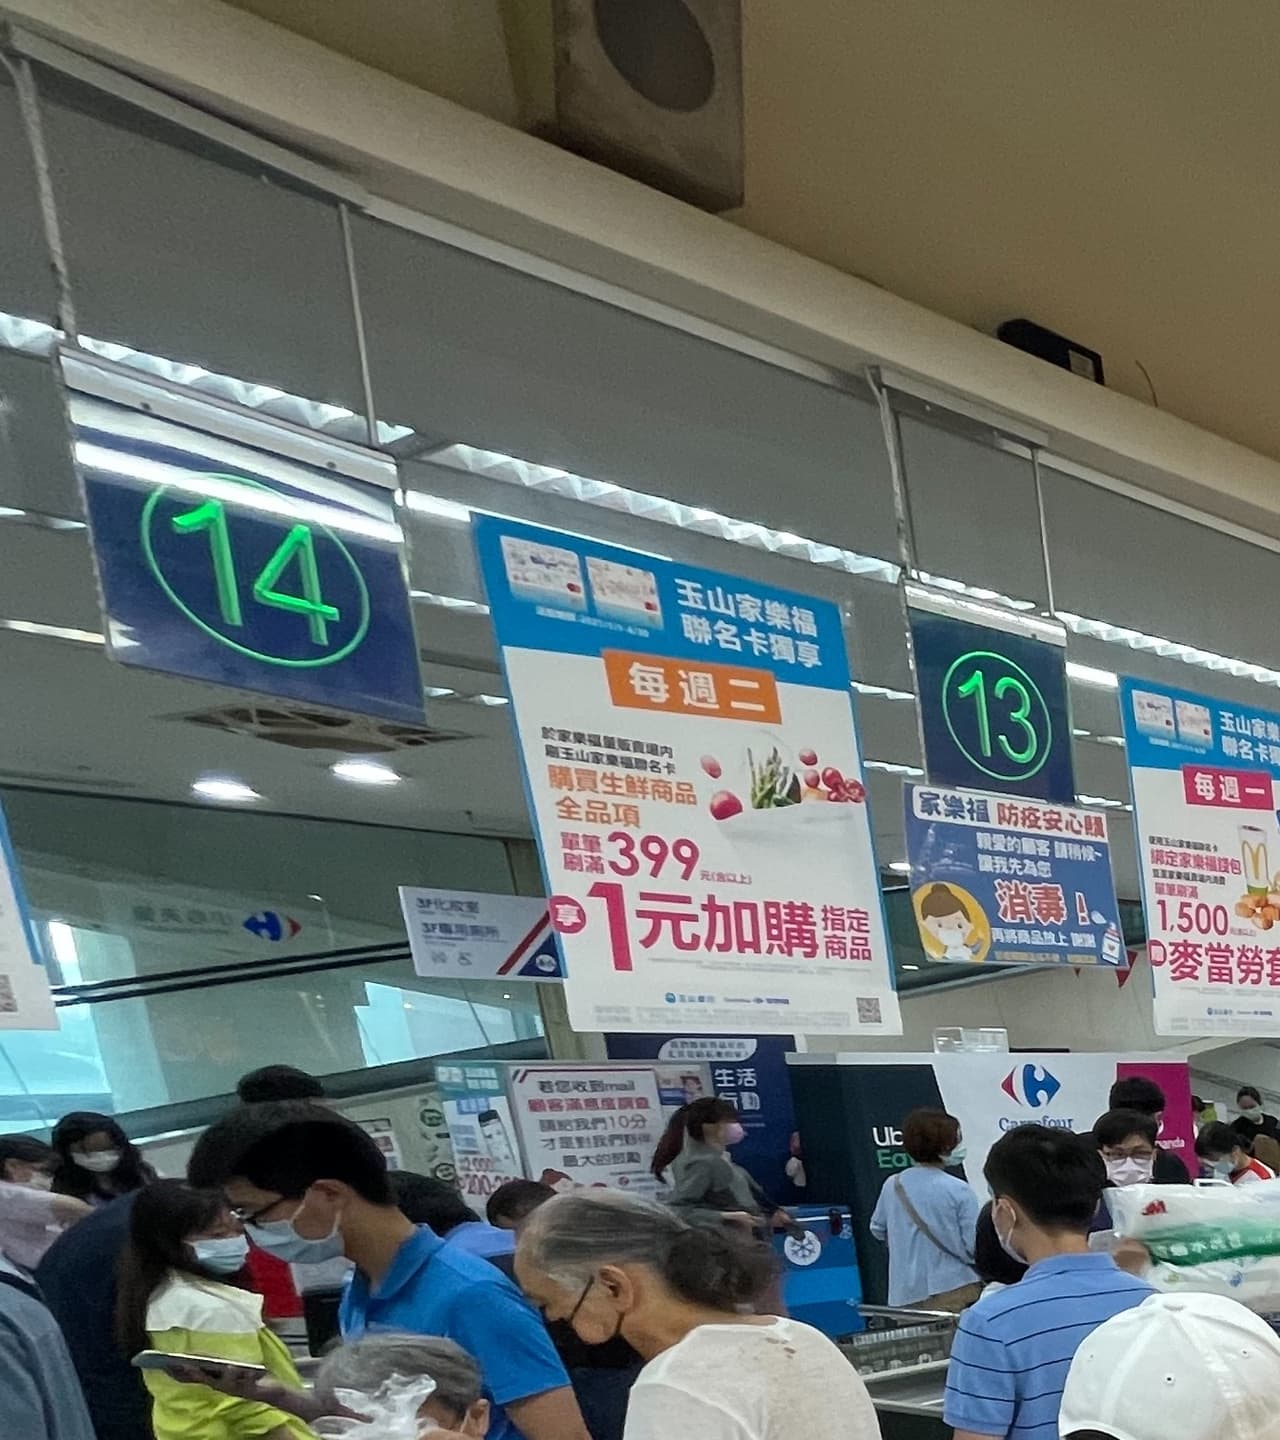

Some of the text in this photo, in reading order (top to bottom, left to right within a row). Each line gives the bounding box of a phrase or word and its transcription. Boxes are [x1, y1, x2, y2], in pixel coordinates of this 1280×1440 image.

[172, 500, 340, 646] 14
[674, 577, 817, 639] 玉山家樂福
[682, 614, 822, 669] 聯名卡獨享
[628, 661, 766, 713] 每週二
[958, 670, 1037, 764] 13
[548, 764, 697, 806] 購買生鮮商品
[1194, 772, 1266, 803] 每週一
[556, 796, 640, 829] 全品項
[608, 831, 699, 881] 399
[586, 882, 819, 973] 1元加購
[821, 905, 871, 934] 指定
[1157, 900, 1228, 936] 1,500
[825, 934, 872, 961] 商品
[714, 1068, 757, 1087] 生活
[873, 1127, 904, 1147] Ub
[878, 1150, 914, 1168] Ea
